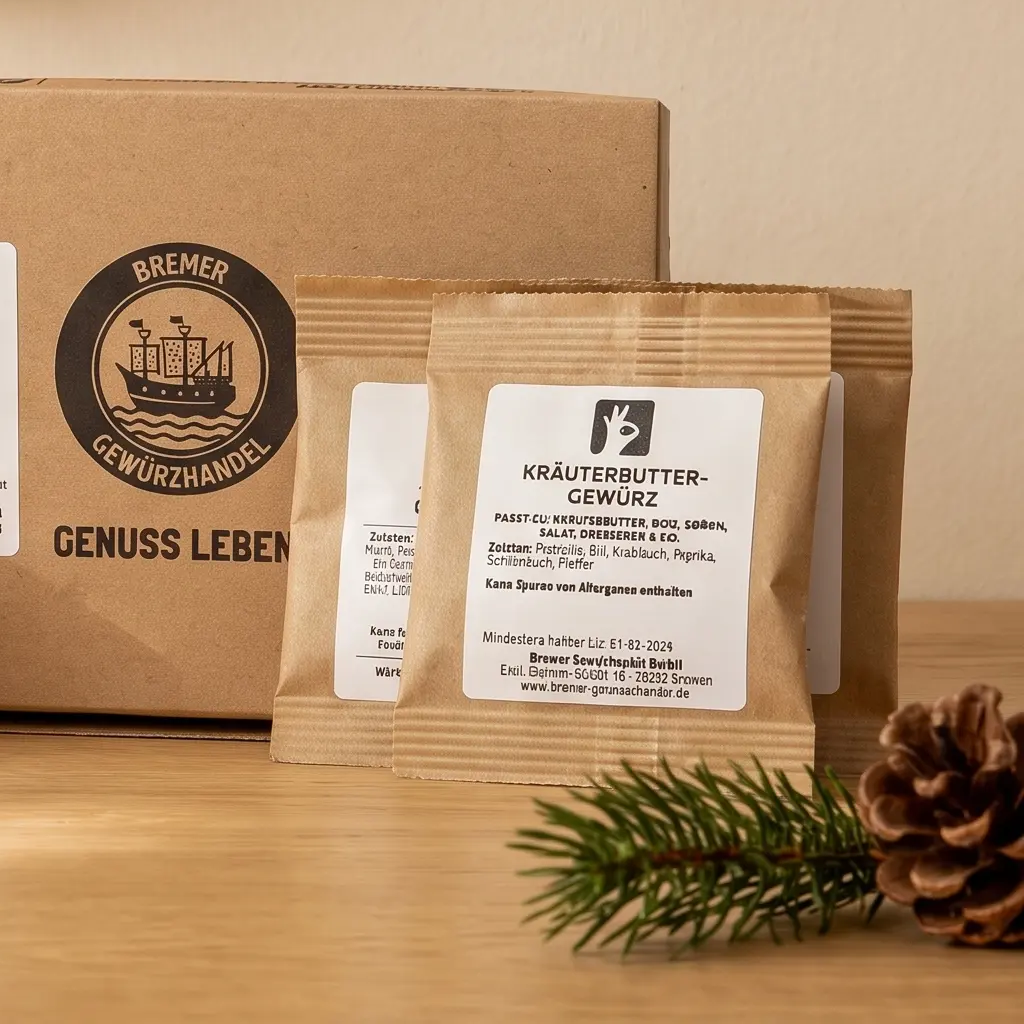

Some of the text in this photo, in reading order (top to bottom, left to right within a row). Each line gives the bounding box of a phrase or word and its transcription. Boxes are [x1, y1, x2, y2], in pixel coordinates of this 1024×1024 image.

[131, 252, 230, 285] BREMER
[92, 433, 272, 489] GEWÜRZHANDEL
[522, 461, 709, 486] KRÄUTERBUTTER-
[567, 486, 659, 508] GEWÜRZ
[53, 525, 181, 560] GENUSS
[539, 528, 577, 540] SALAT,
[649, 532, 656, 542] &
[486, 578, 512, 589] Kana
[556, 583, 576, 592] von
[529, 652, 570, 665] Brewer
[613, 670, 625, 682] 16
